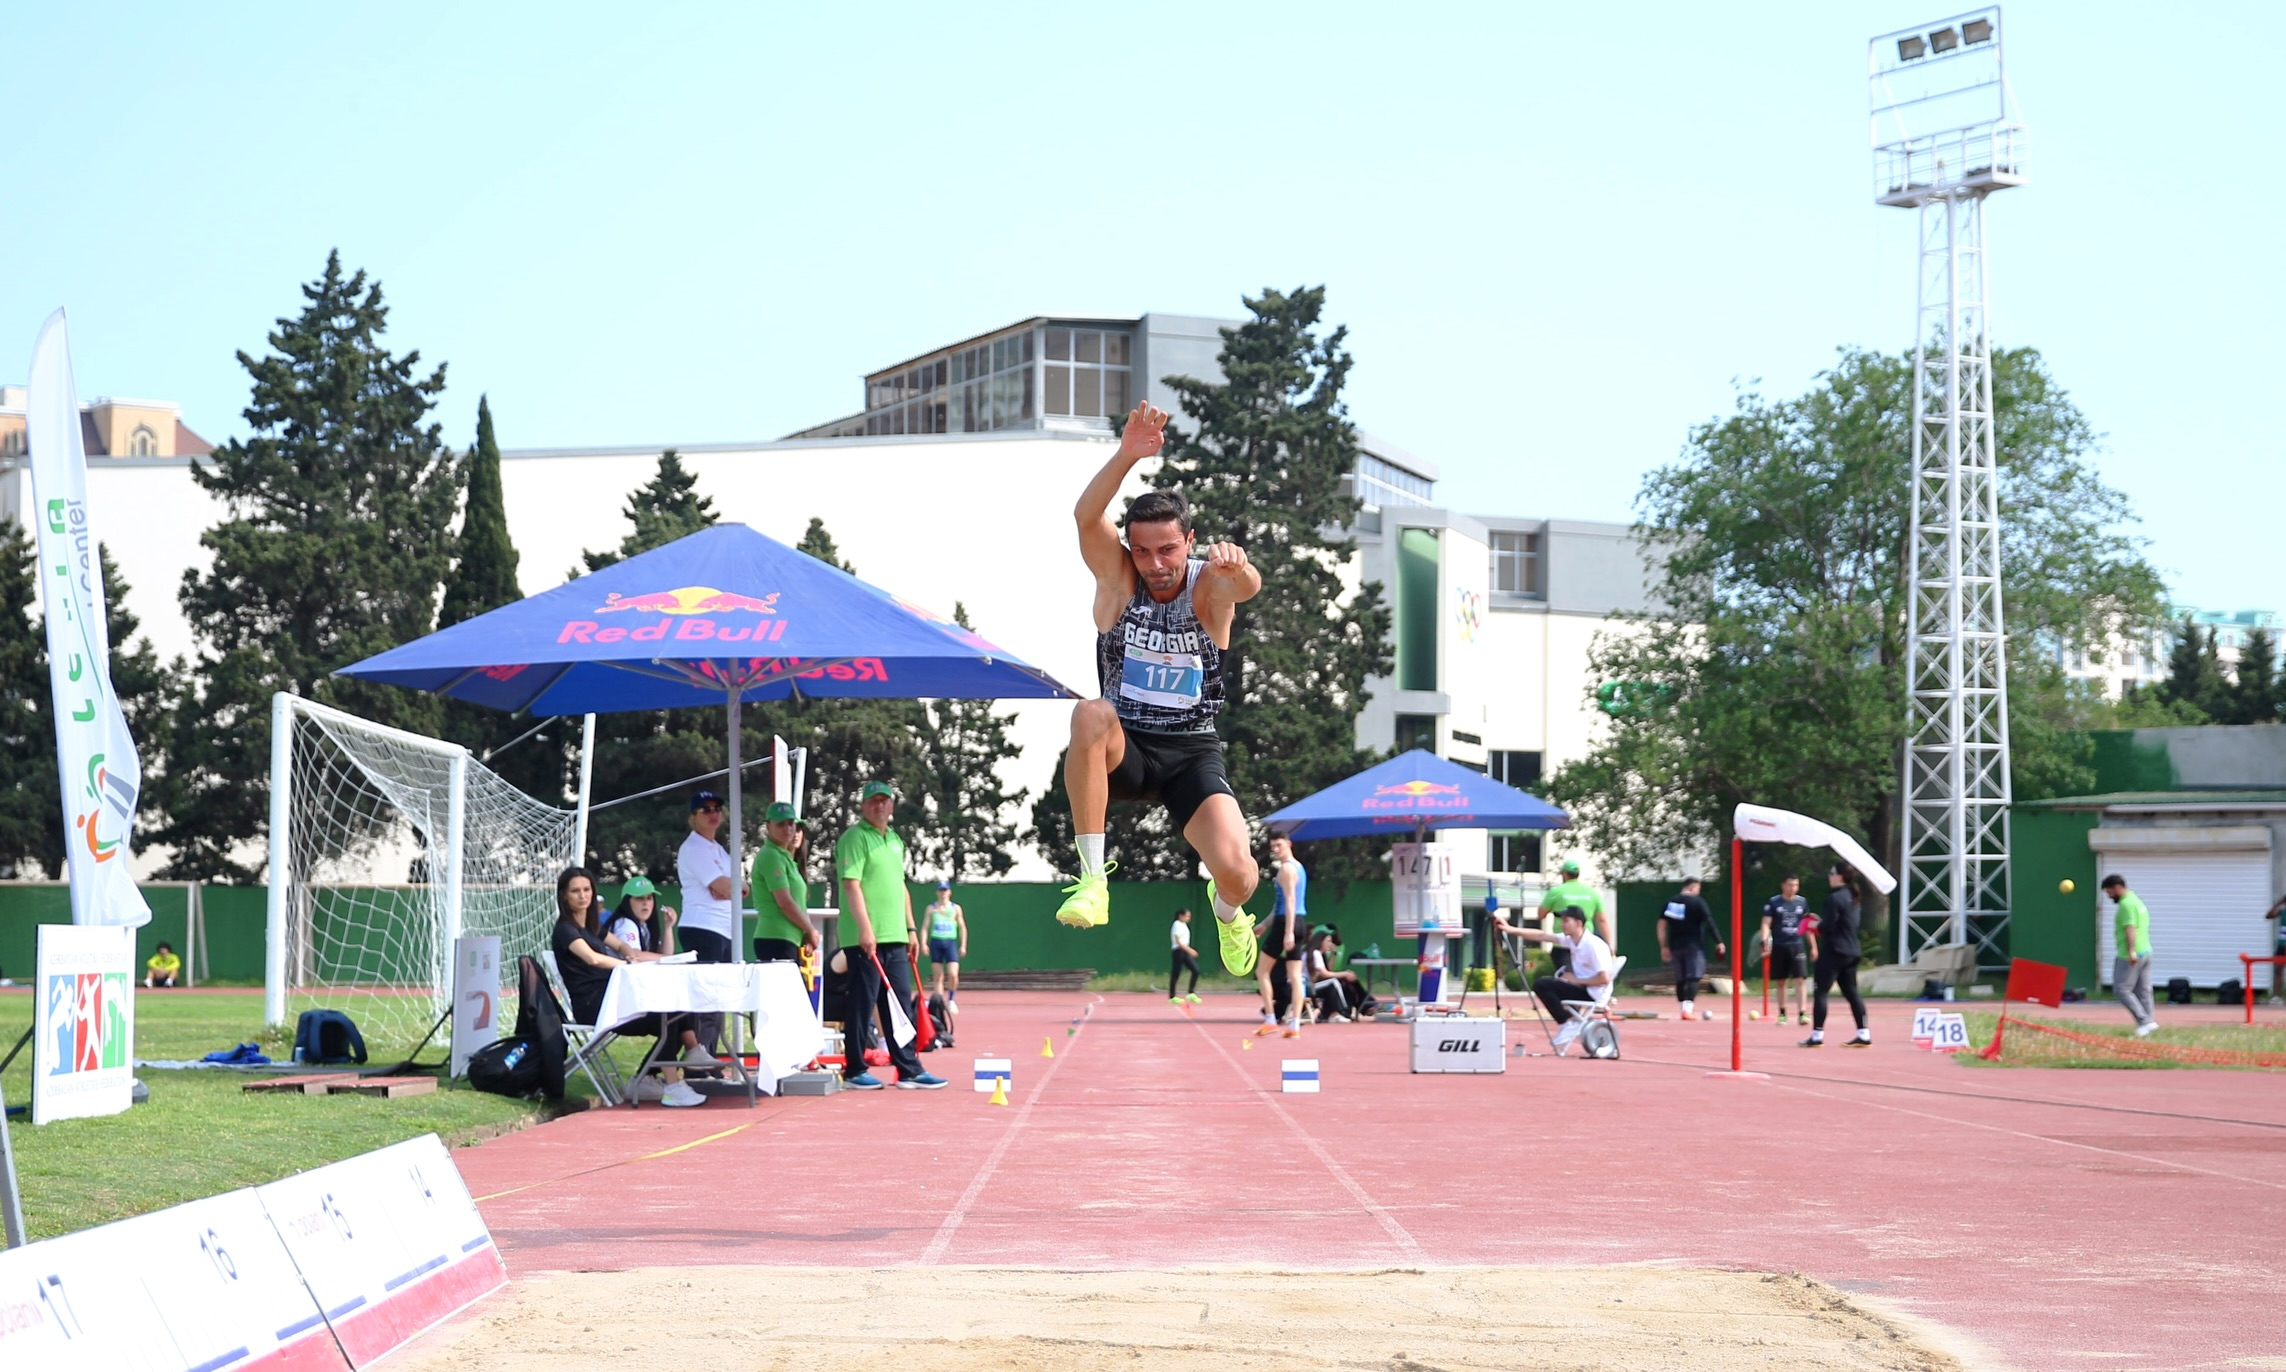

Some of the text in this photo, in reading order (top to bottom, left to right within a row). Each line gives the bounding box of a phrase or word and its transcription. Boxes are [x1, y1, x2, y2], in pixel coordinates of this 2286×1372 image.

[557, 618, 788, 644] Red Bull
[1145, 665, 1185, 690] 117
[1362, 796, 1469, 809] Red Bull
[1438, 1039, 1480, 1052] GILL
[1938, 1023, 1964, 1043] 18
[408, 1163, 436, 1208] 14
[320, 1193, 353, 1242] 15
[199, 1227, 239, 1285] 16
[36, 1273, 84, 1340] 17
